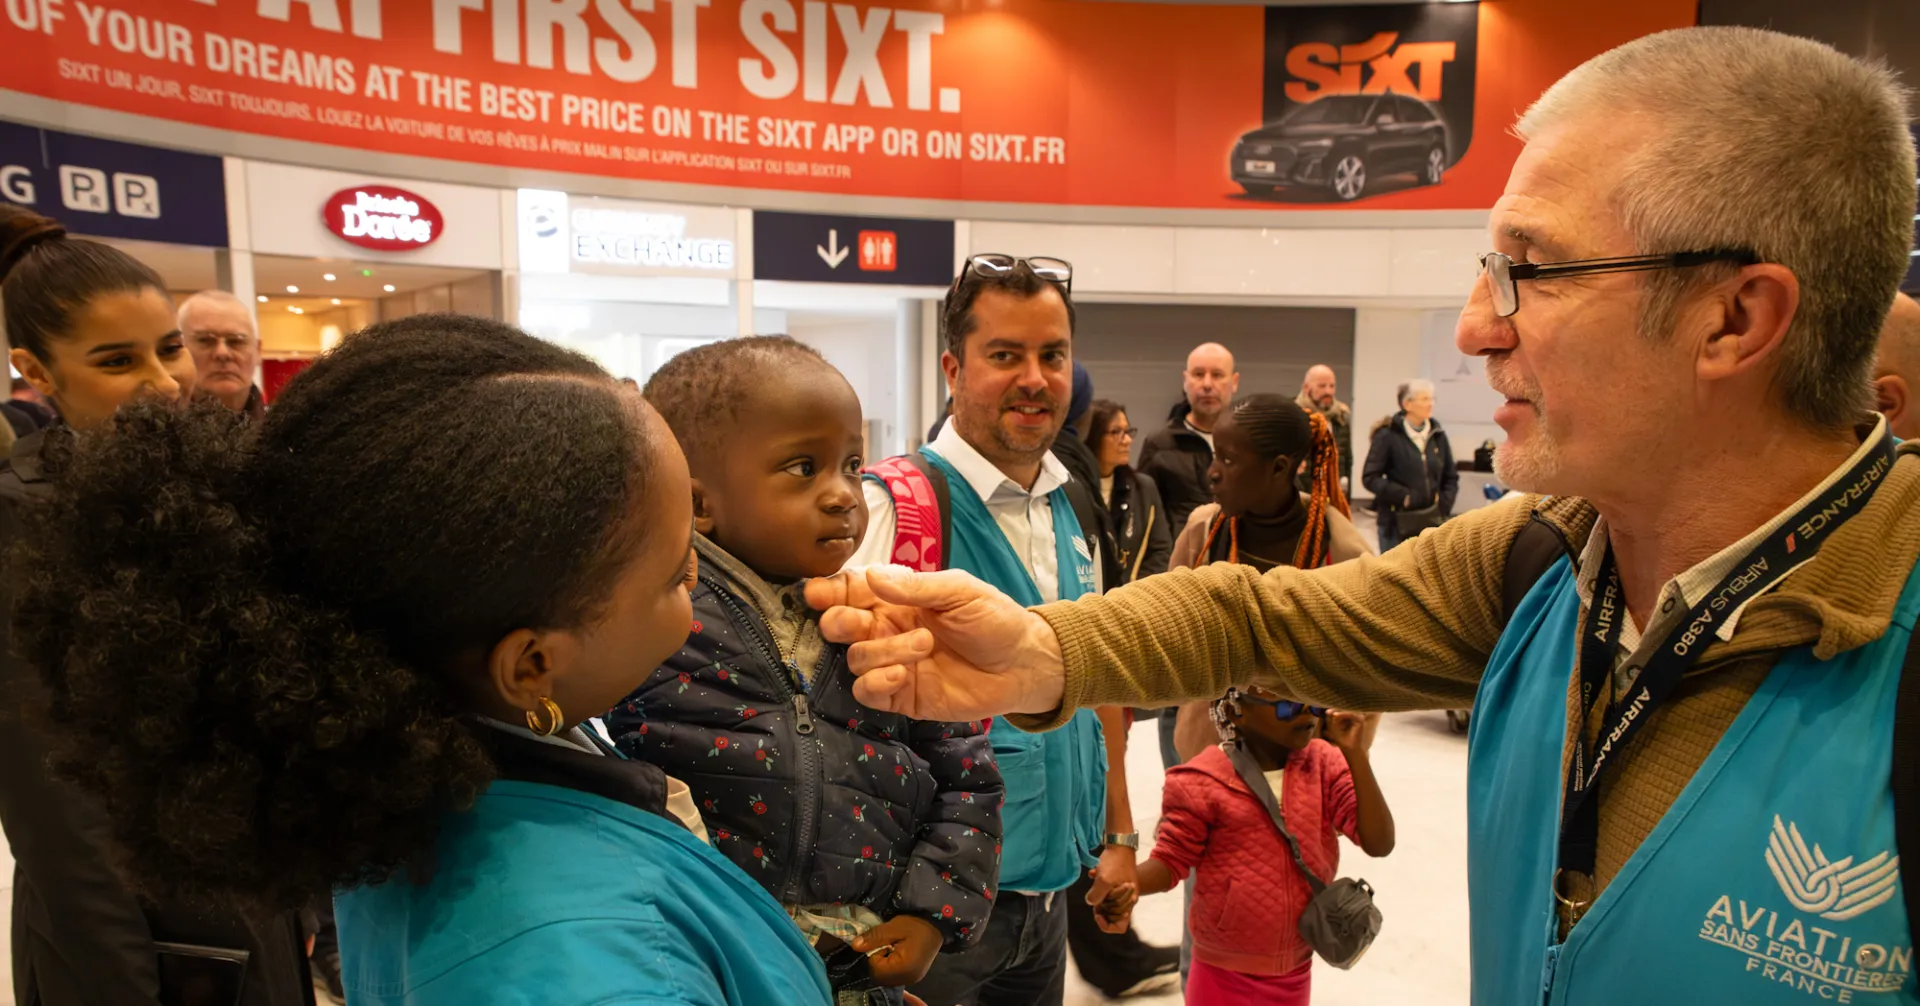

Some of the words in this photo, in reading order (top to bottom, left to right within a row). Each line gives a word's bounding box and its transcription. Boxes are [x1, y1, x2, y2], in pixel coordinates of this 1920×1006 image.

[5, 0, 65, 36] OF
[75, 1, 195, 66] YOUR
[204, 32, 356, 95] DREAMS
[364, 63, 404, 101] AT
[410, 71, 472, 112] THE
[480, 82, 553, 123] BEST
[562, 94, 645, 134] PRICE
[652, 105, 691, 138] ON
[698, 110, 750, 144] THE
[757, 117, 816, 150] SIXT
[823, 123, 875, 154] APP
[883, 126, 918, 157] OR
[926, 130, 962, 160] ON
[969, 132, 1065, 164] SIXT.FR
[738, 0, 961, 113] SIXT.
[1284, 31, 1456, 104] SIXT
[58, 58, 101, 83] SIXT
[104, 68, 132, 91] UN
[135, 75, 186, 102] JOUR,
[188, 84, 223, 107] SIXT
[229, 92, 314, 122] TOUJOURS.
[317, 106, 363, 129] LOUEZ
[365, 114, 384, 132] LA
[384, 117, 444, 139] VOITURE
[447, 125, 466, 143] DE
[467, 128, 494, 146] VOS
[540, 134, 550, 152] À
[551, 138, 581, 156] PRIX
[583, 142, 623, 161] MALIN
[624, 146, 650, 162] SUR
[737, 156, 763, 173] SIXT
[765, 159, 782, 174] OU
[784, 162, 809, 177] SUR
[811, 162, 852, 180] SIXT.FR
[0, 164, 36, 204] G
[575, 232, 734, 268] EXCHANGE
[1797, 453, 1889, 539] AIRFRANCE
[1711, 556, 1769, 611] AIRBUS
[1674, 608, 1713, 656] A380
[1700, 919, 1760, 950] SANS
[1706, 895, 1913, 973] AVIATION
[1746, 957, 1853, 1005] FRANCE
